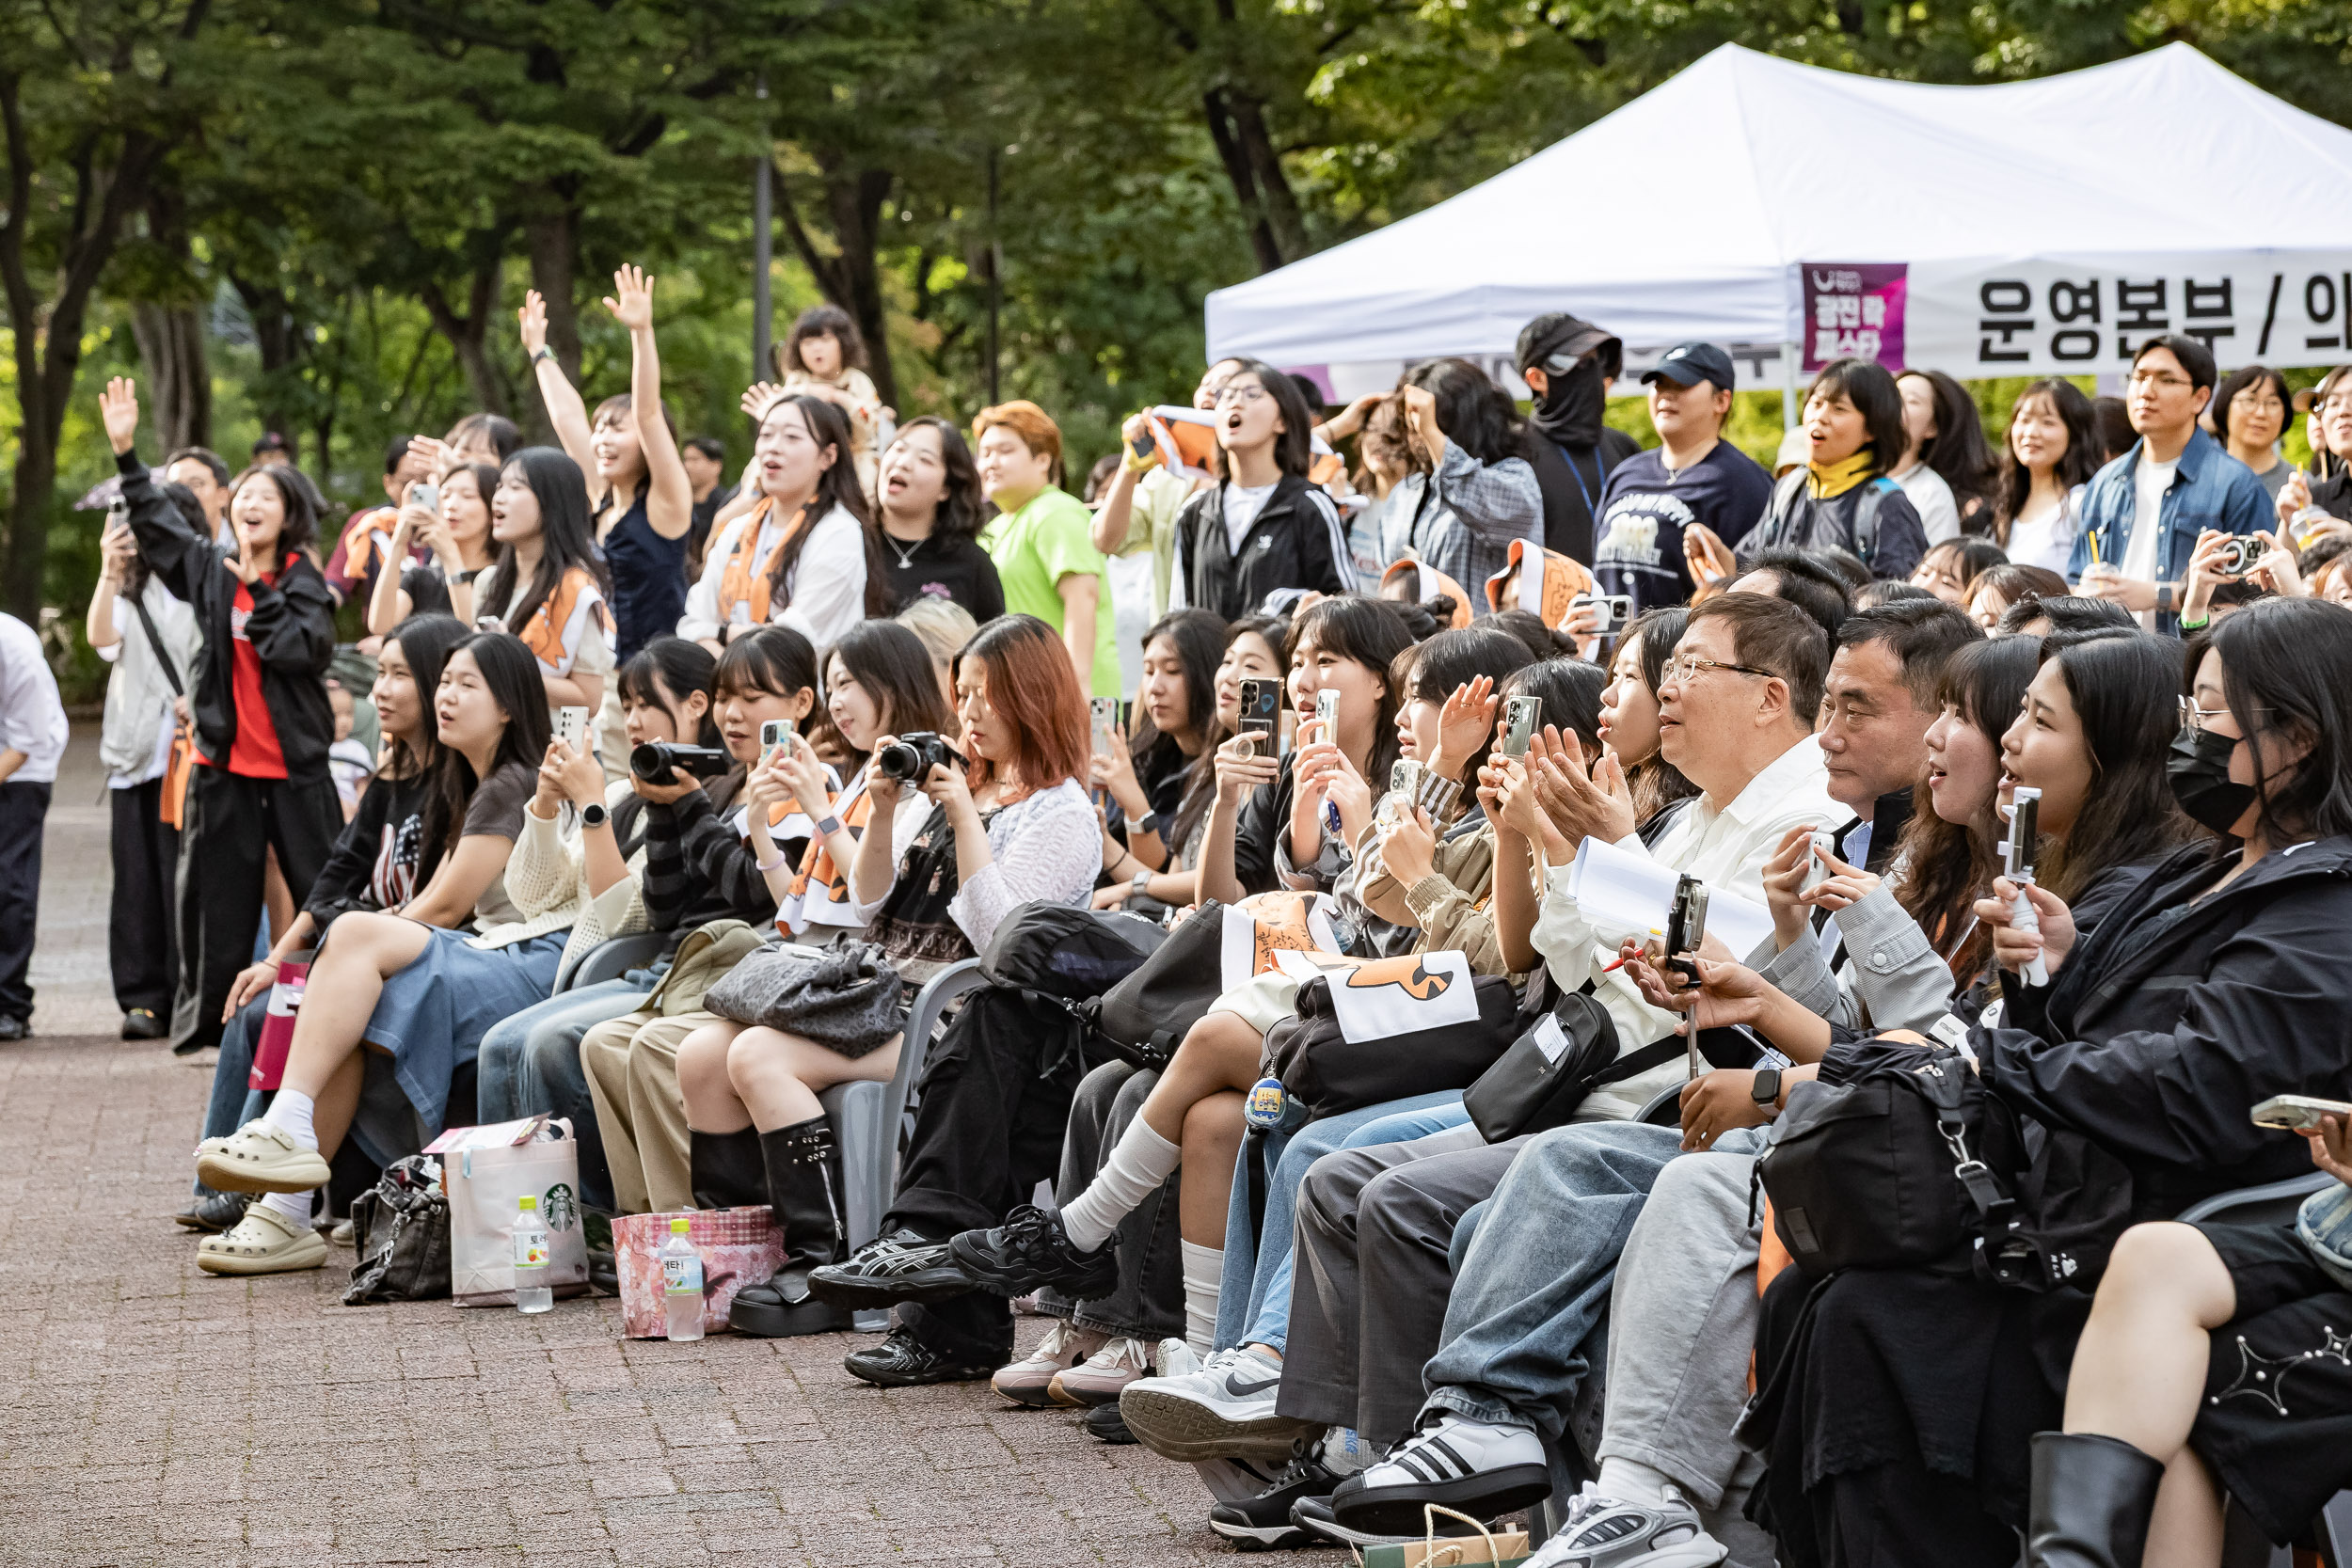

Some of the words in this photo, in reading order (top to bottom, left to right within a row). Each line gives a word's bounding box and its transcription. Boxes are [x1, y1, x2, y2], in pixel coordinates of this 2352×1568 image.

[1979, 278, 2234, 361] 운영본부
[2257, 274, 2282, 356] /
[2306, 272, 2352, 351] 의
